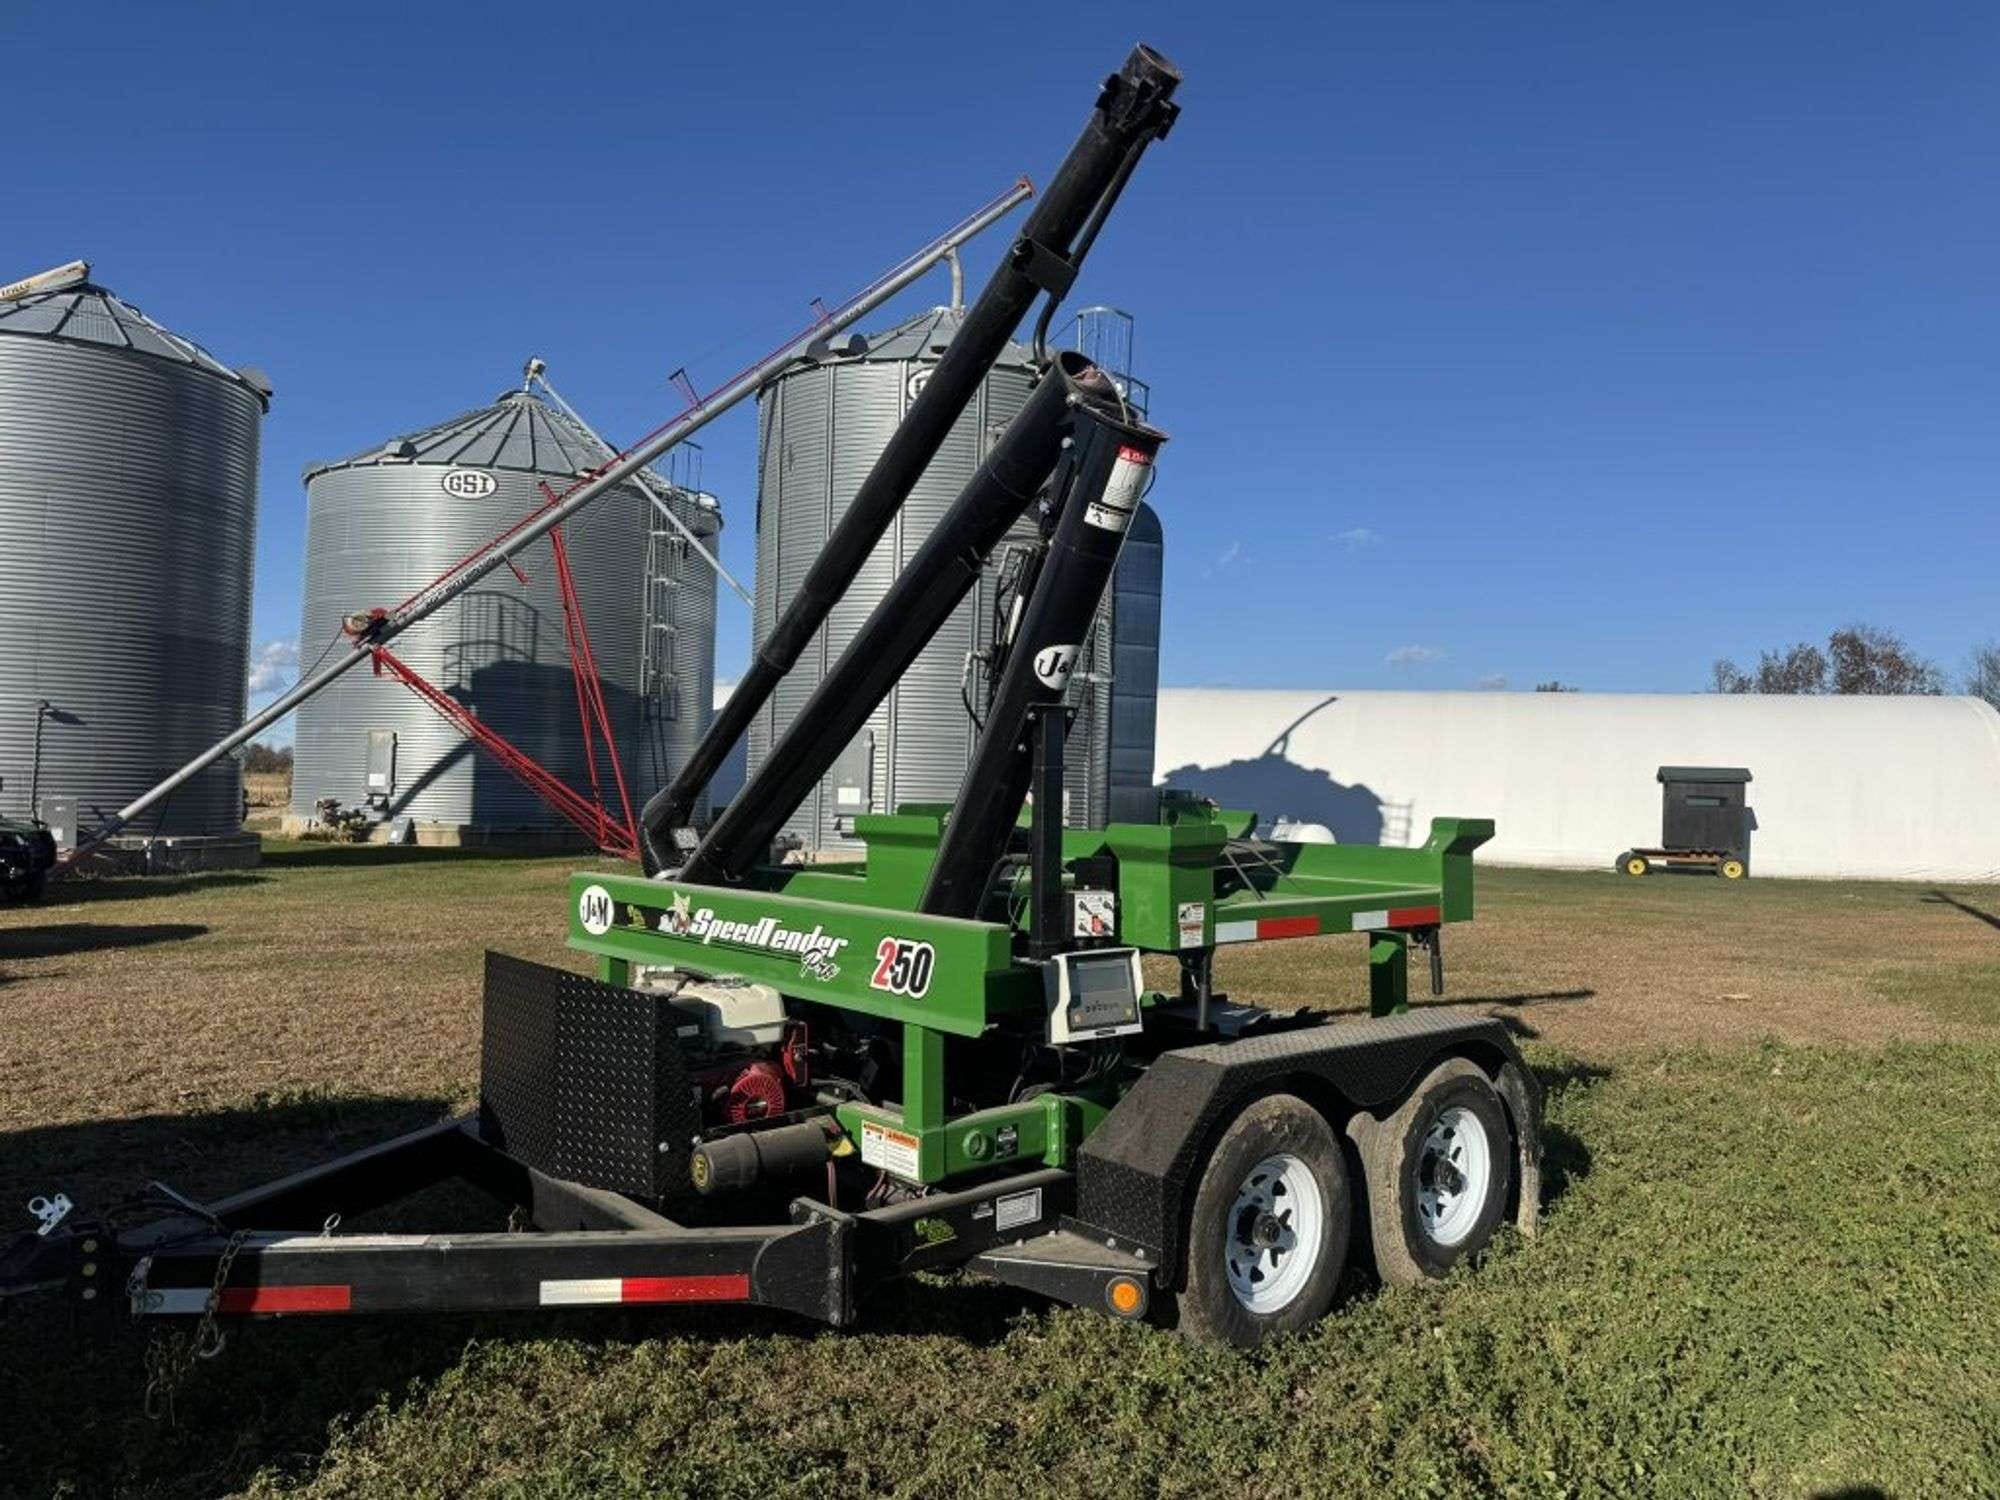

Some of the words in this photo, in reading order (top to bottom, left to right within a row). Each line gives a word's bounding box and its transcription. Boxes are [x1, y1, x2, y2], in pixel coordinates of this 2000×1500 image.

[449, 474, 490, 494] GSI
[582, 894, 609, 927] J&M
[689, 907, 849, 958] SpeedTender
[800, 947, 841, 982] Pro
[871, 936, 935, 998] 250
